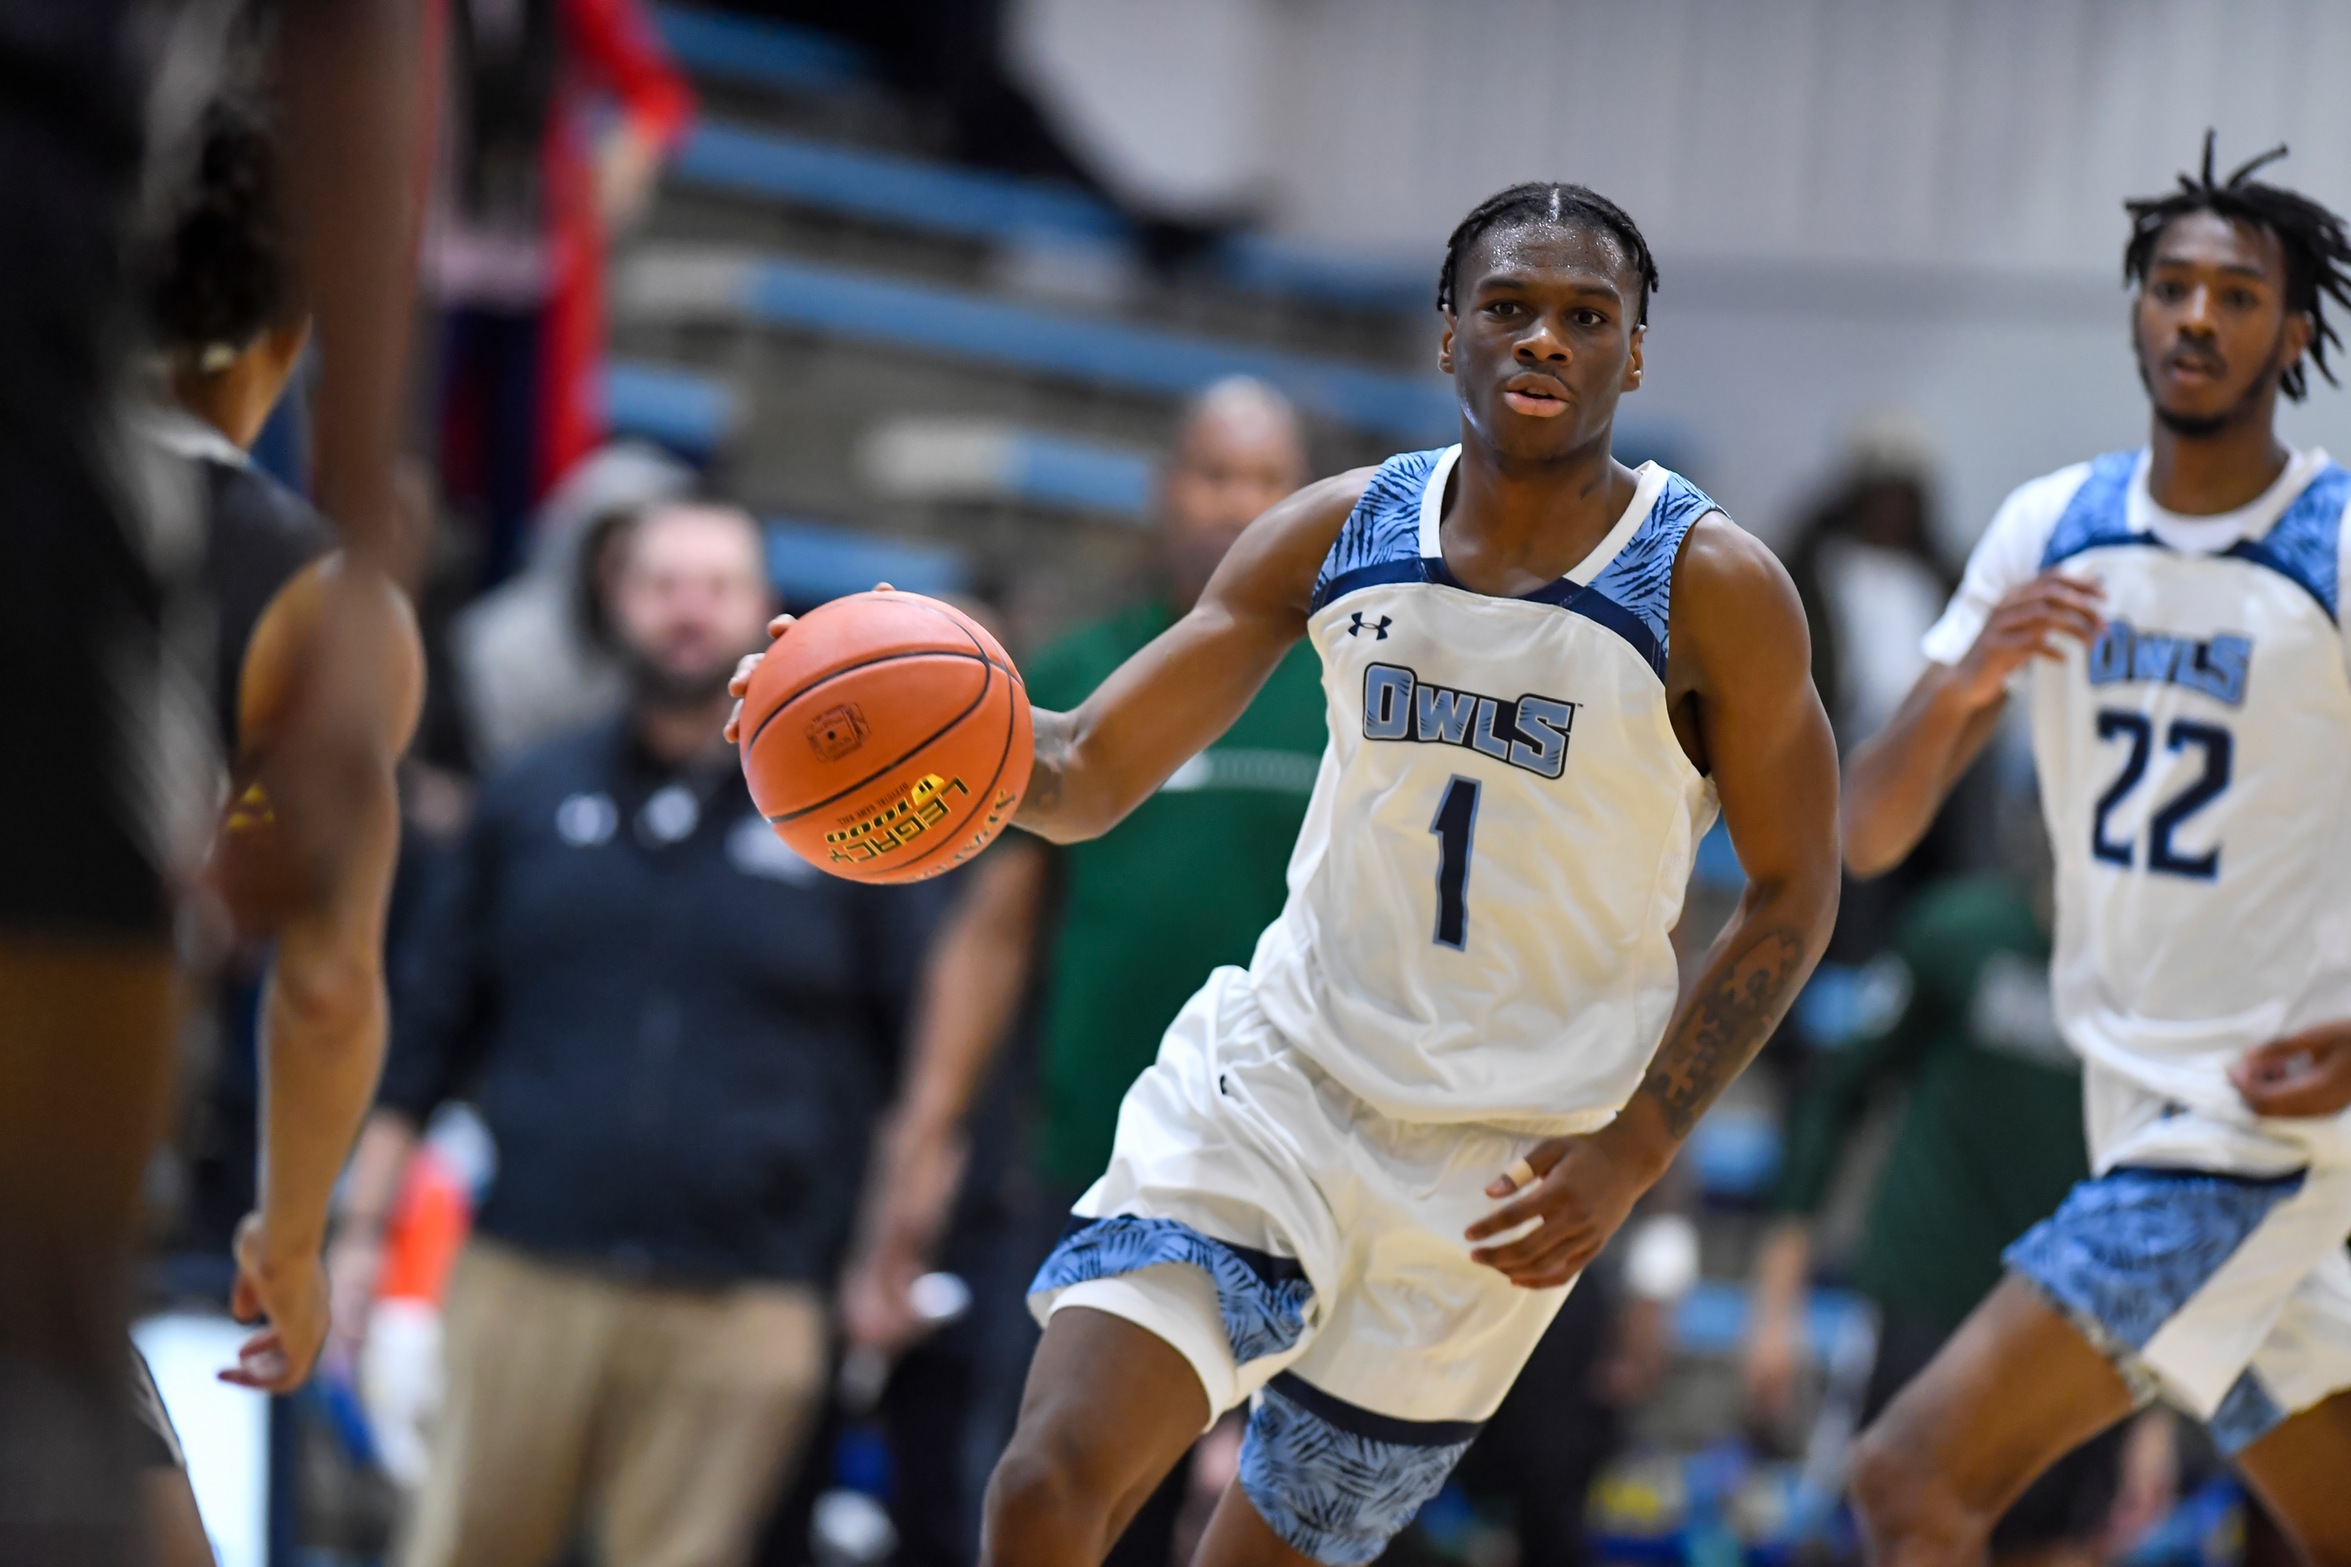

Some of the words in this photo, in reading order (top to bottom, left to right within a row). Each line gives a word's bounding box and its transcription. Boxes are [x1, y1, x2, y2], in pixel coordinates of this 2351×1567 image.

[1363, 662, 1575, 779] OWLS
[2089, 618, 2254, 710] OWLS
[829, 776, 971, 864] LEGACY
[2092, 706, 2234, 882] 22
[1429, 773, 1481, 952] 1
